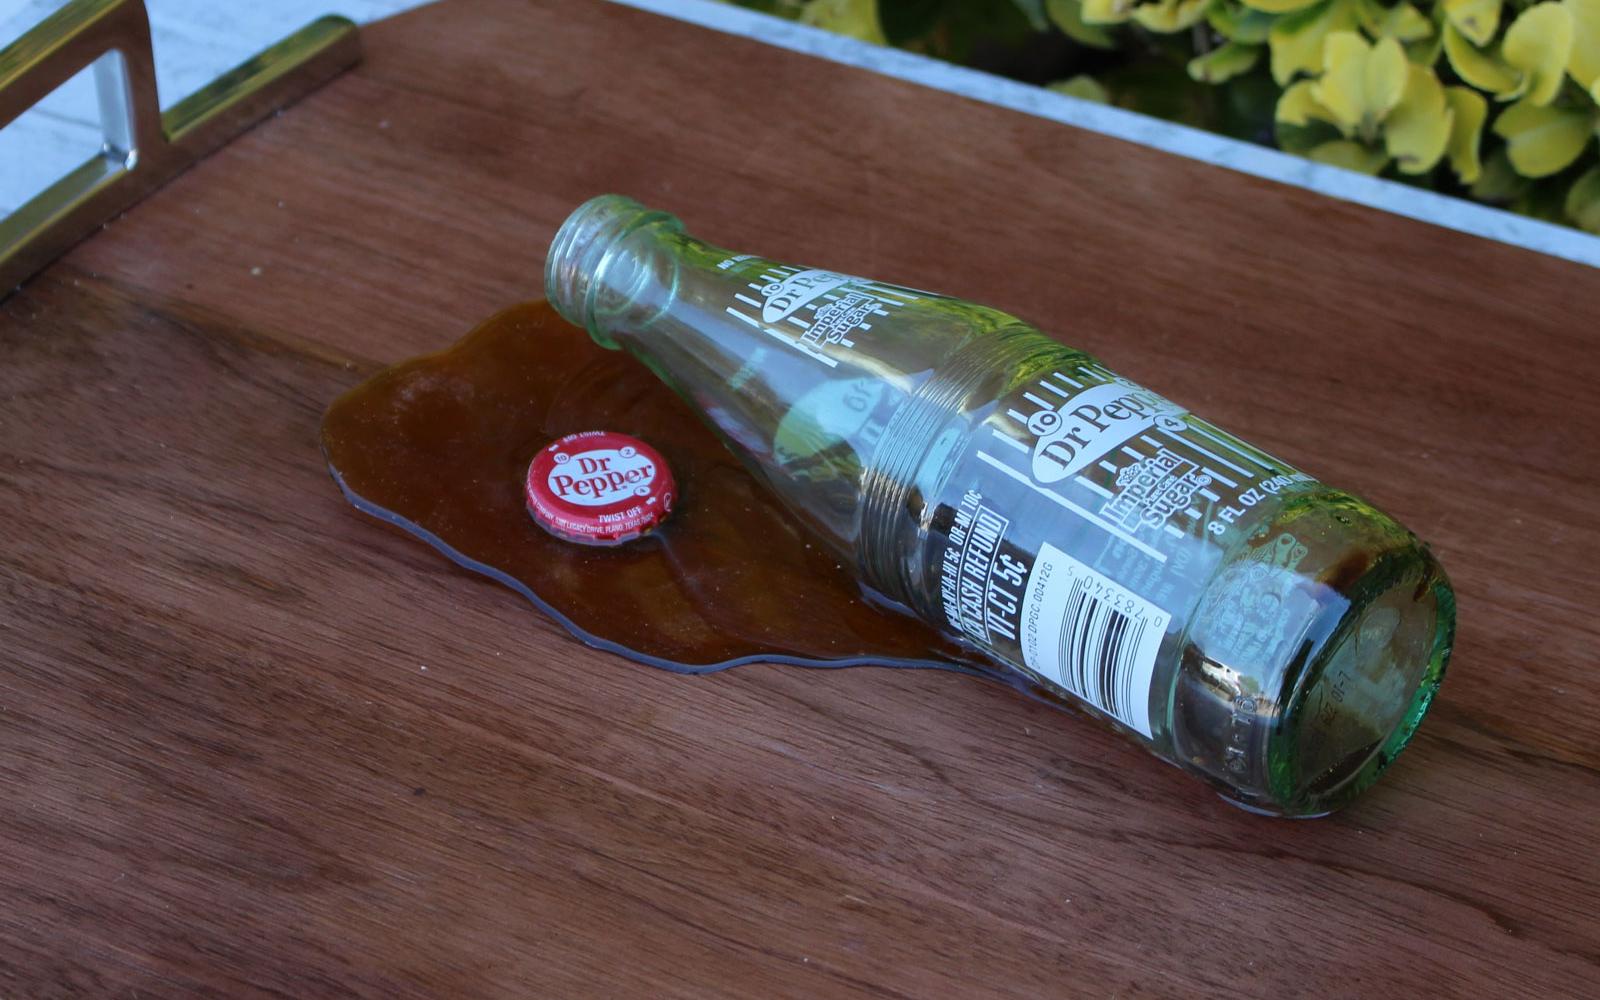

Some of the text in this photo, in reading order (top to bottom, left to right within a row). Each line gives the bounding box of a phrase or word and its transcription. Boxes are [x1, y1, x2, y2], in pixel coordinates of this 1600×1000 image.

[764, 284, 781, 296] 10
[769, 286, 801, 312] Dr
[803, 291, 862, 343] Imperial
[828, 302, 875, 344] Sugar
[1032, 413, 1057, 434] 10
[556, 454, 567, 462] 10
[1038, 426, 1092, 471] Dr
[552, 464, 652, 499] Pepper
[577, 457, 611, 475] Dr
[964, 490, 983, 512] 10¢
[1101, 450, 1183, 521] Imperial
[1141, 470, 1200, 528] Sugar
[599, 506, 642, 523] TWIST OFF
[949, 512, 971, 545] OR-MI
[1208, 521, 1225, 535] 8
[1218, 503, 1246, 523] FL
[1239, 488, 1265, 507] OZ
[944, 545, 961, 562] 5¢
[961, 512, 1002, 638] CA CASH REFUND
[987, 551, 1028, 641] VT-CT 5¢
[1083, 575, 1145, 624] 783340
[1153, 616, 1163, 628] 0
